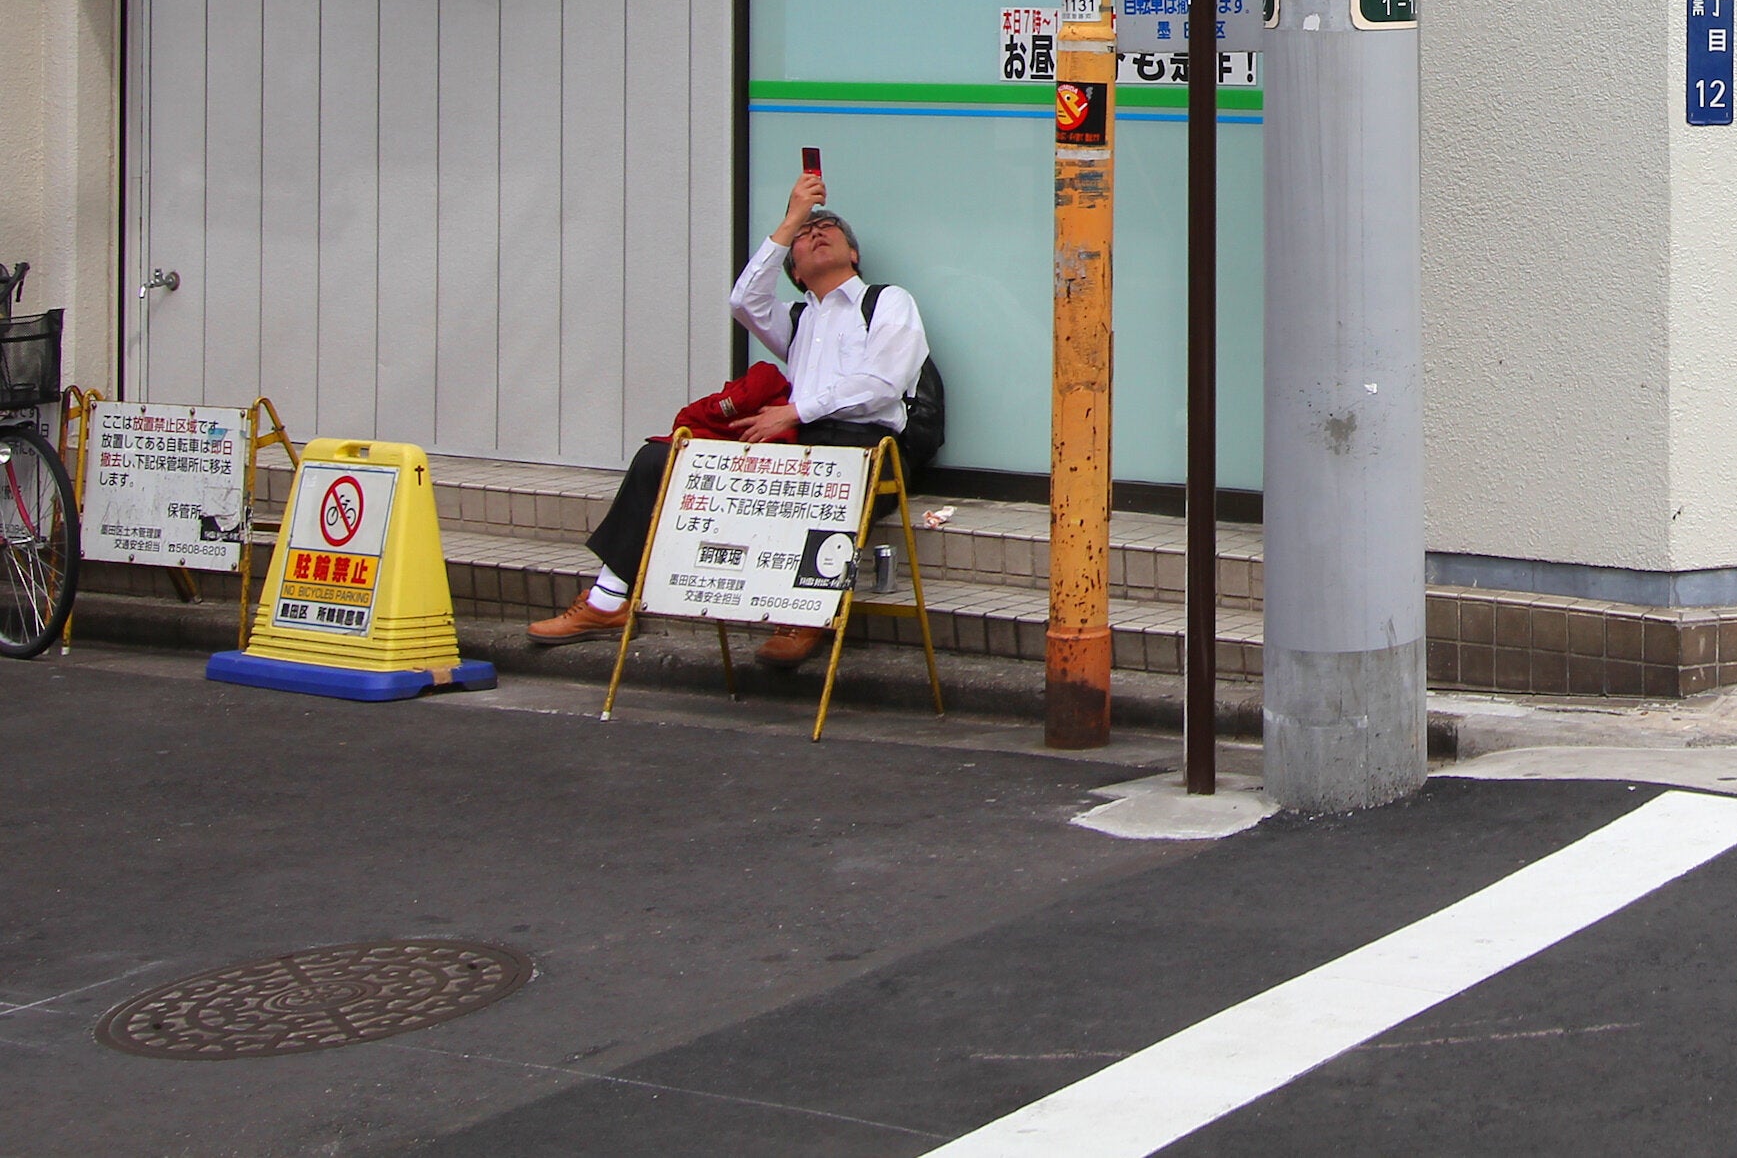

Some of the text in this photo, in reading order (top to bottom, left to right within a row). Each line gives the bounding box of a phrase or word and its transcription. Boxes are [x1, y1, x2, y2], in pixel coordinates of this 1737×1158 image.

[1695, 79, 1726, 108] 12
[101, 434, 233, 455] 放置してある自転車は即日
[100, 452, 232, 475] 撤去し、下記保管場所に移送
[691, 453, 842, 478] ここは放置禁止区域です。
[99, 473, 135, 488] します。
[685, 474, 851, 500] 放置してある自転車は即日
[679, 494, 847, 522] 撤去し、下記保管場所に移送
[675, 516, 719, 534] します。
[114, 539, 160, 553] 交通安全担当
[293, 553, 368, 584] 駐輪禁止
[756, 550, 801, 571] 保管所
[669, 574, 746, 591] 墨田区土木管理課
[284, 584, 370, 604] NO BICYCLES PARKING
[684, 590, 741, 606] 交通安全担当
[759, 596, 822, 611] 5608-6203
